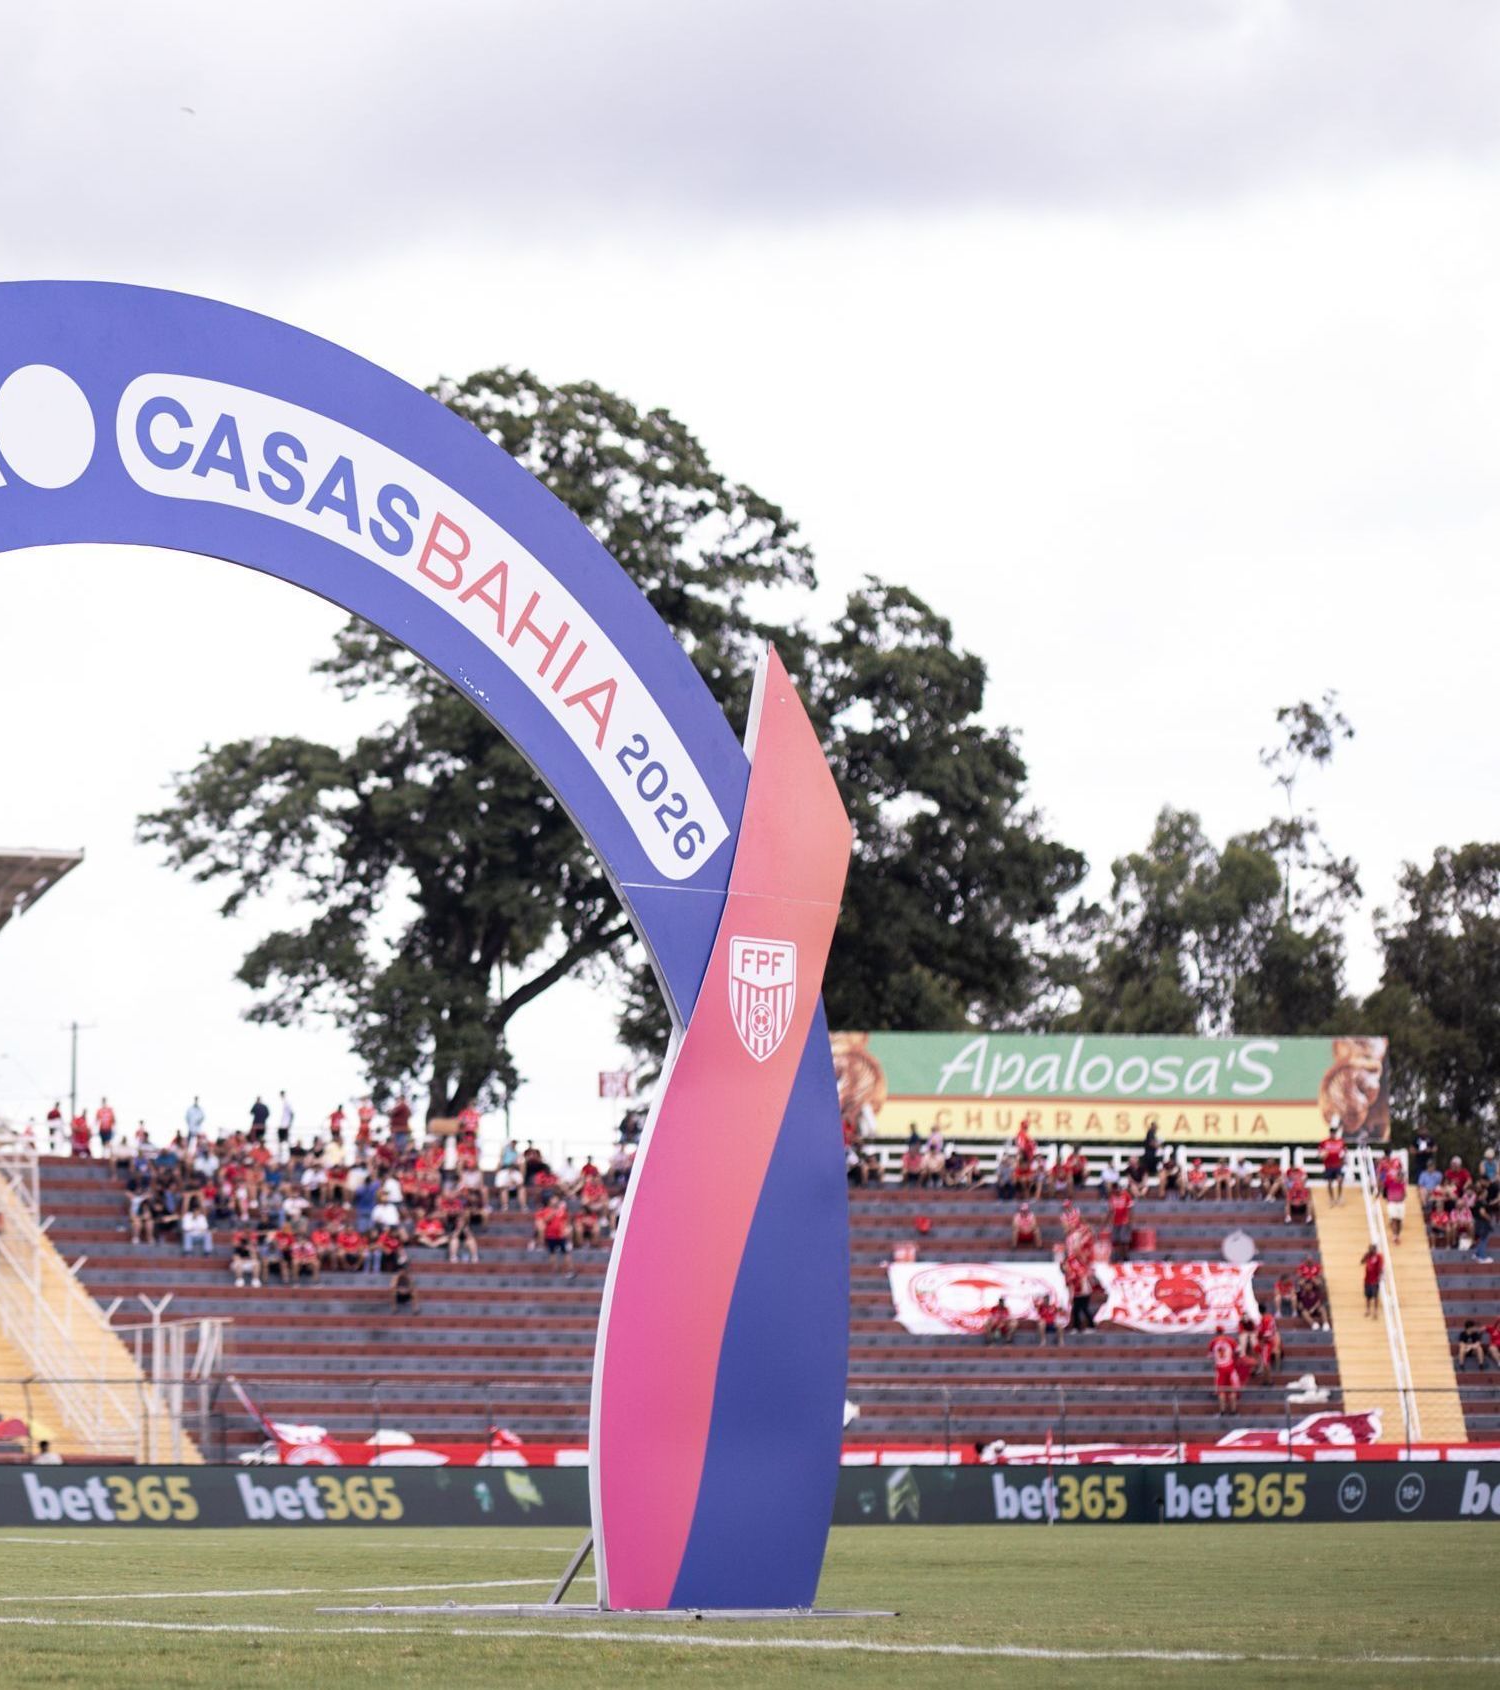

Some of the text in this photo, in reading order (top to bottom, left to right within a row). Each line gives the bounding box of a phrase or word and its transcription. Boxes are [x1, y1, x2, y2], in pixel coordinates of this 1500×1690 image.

[615, 733, 706, 861] 2026
[740, 948, 786, 977] FPF
[934, 1035, 1280, 1098] Apaloosa'S
[22, 1472, 199, 1522] bet365
[235, 1472, 404, 1521] bet365
[991, 1472, 1128, 1520] bet365
[1164, 1471, 1308, 1519] bet365
